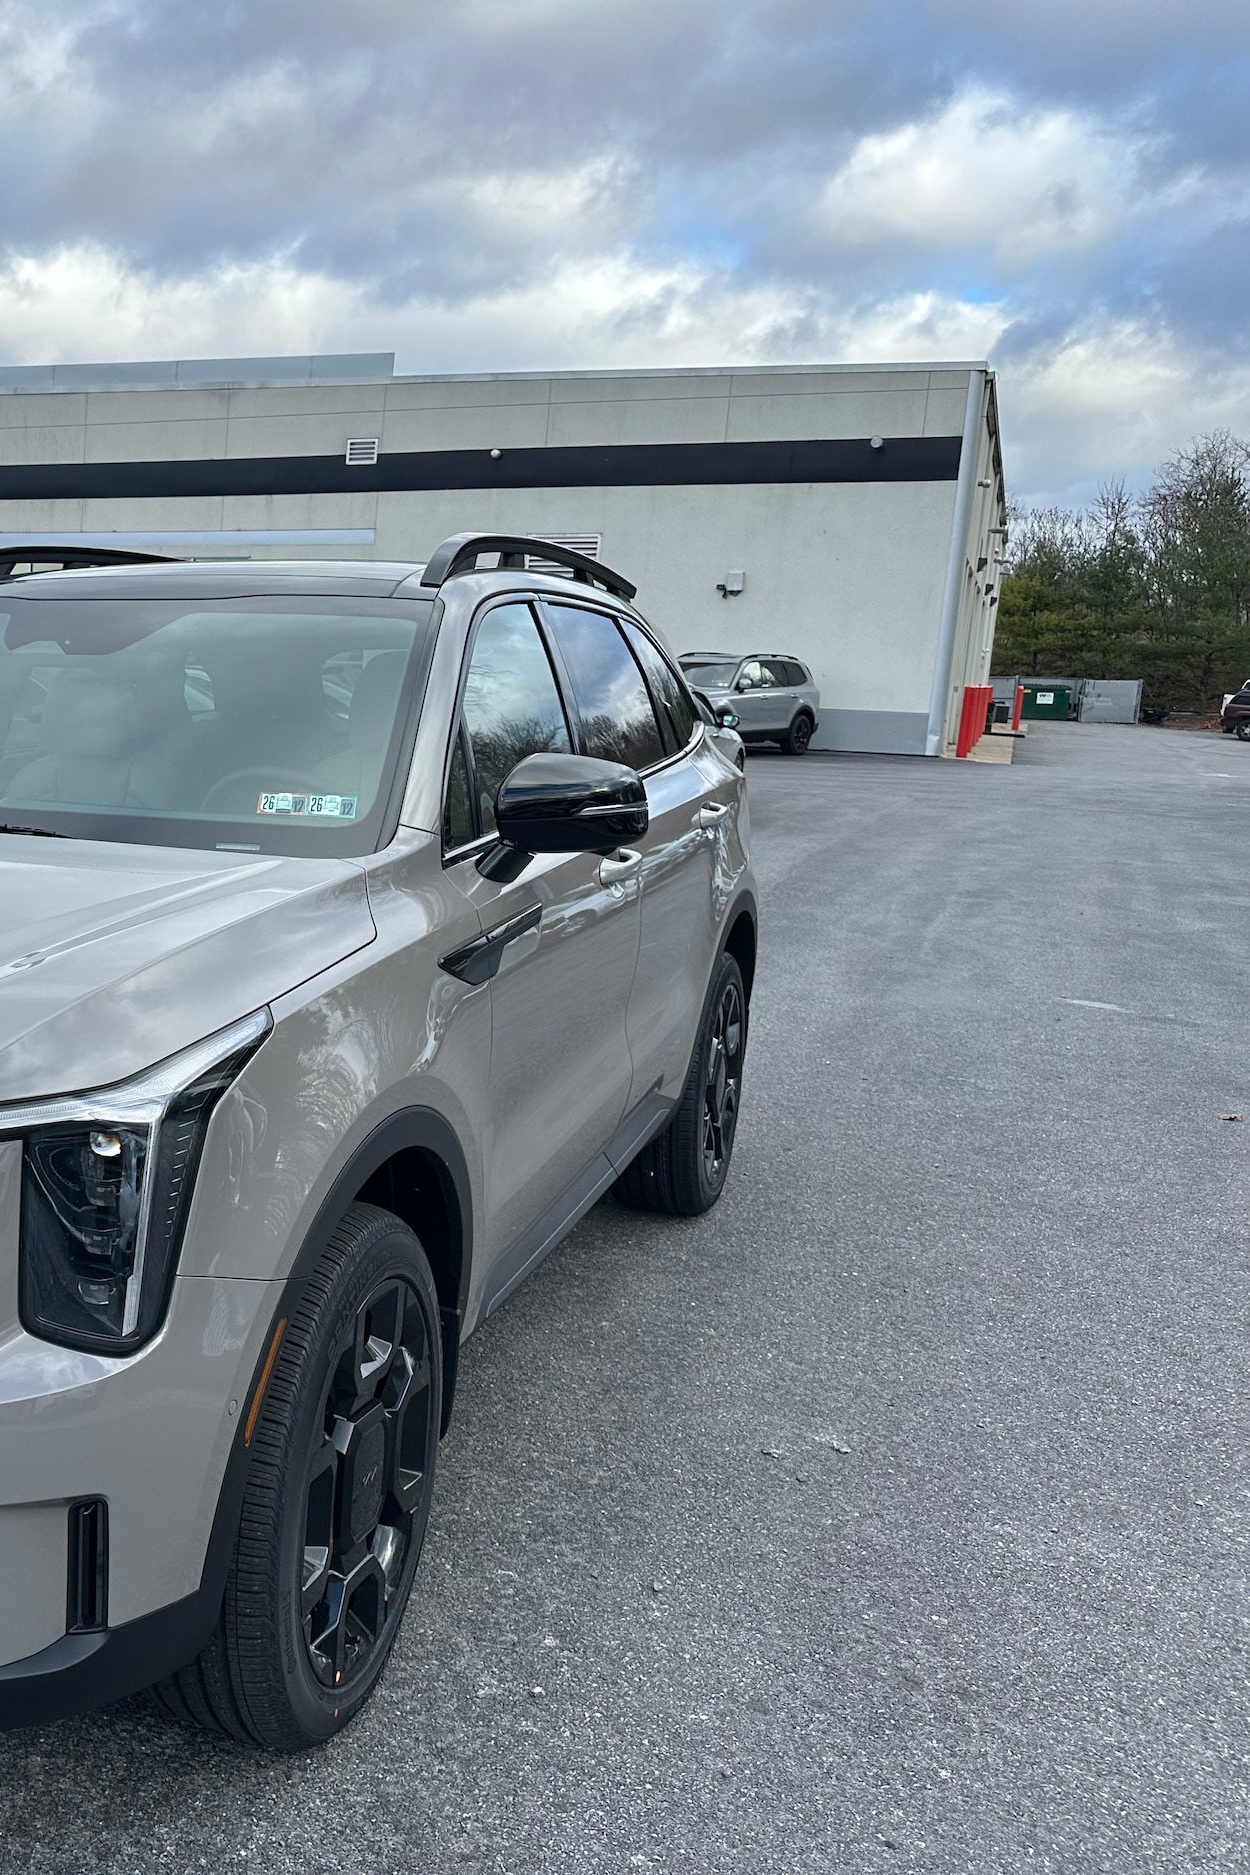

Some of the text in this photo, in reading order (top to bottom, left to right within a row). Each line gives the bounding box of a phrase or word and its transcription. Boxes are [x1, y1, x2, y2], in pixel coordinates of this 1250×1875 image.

[262, 795, 305, 813] 26 12
[310, 797, 354, 816] 26 12
